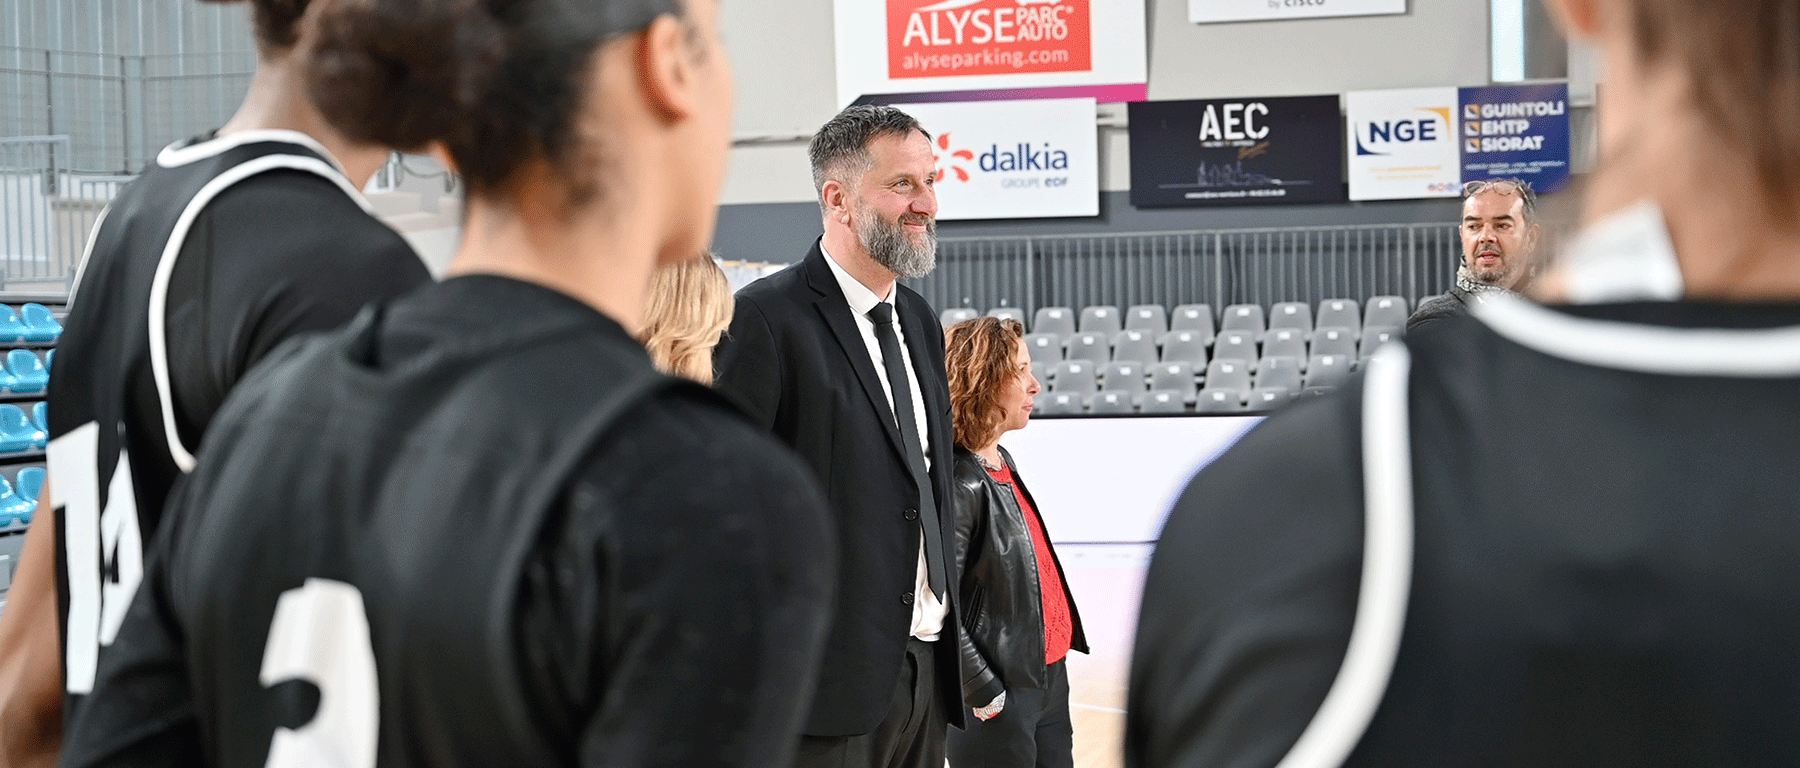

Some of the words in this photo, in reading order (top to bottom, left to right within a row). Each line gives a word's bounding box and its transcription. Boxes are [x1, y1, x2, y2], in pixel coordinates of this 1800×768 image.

[902, 8, 1016, 47] ALYSE
[1016, 5, 1066, 26] PARC
[1017, 22, 1068, 41] AUTO
[902, 48, 1069, 71] alyseparking.com
[1199, 102, 1270, 140] AEC
[1480, 101, 1564, 118] GUINTOLI
[1369, 119, 1437, 143] NGE
[1480, 119, 1530, 135] EHTP
[1480, 135, 1545, 152] SIORAT
[979, 142, 1068, 172] dalkia
[45, 419, 144, 694] 14
